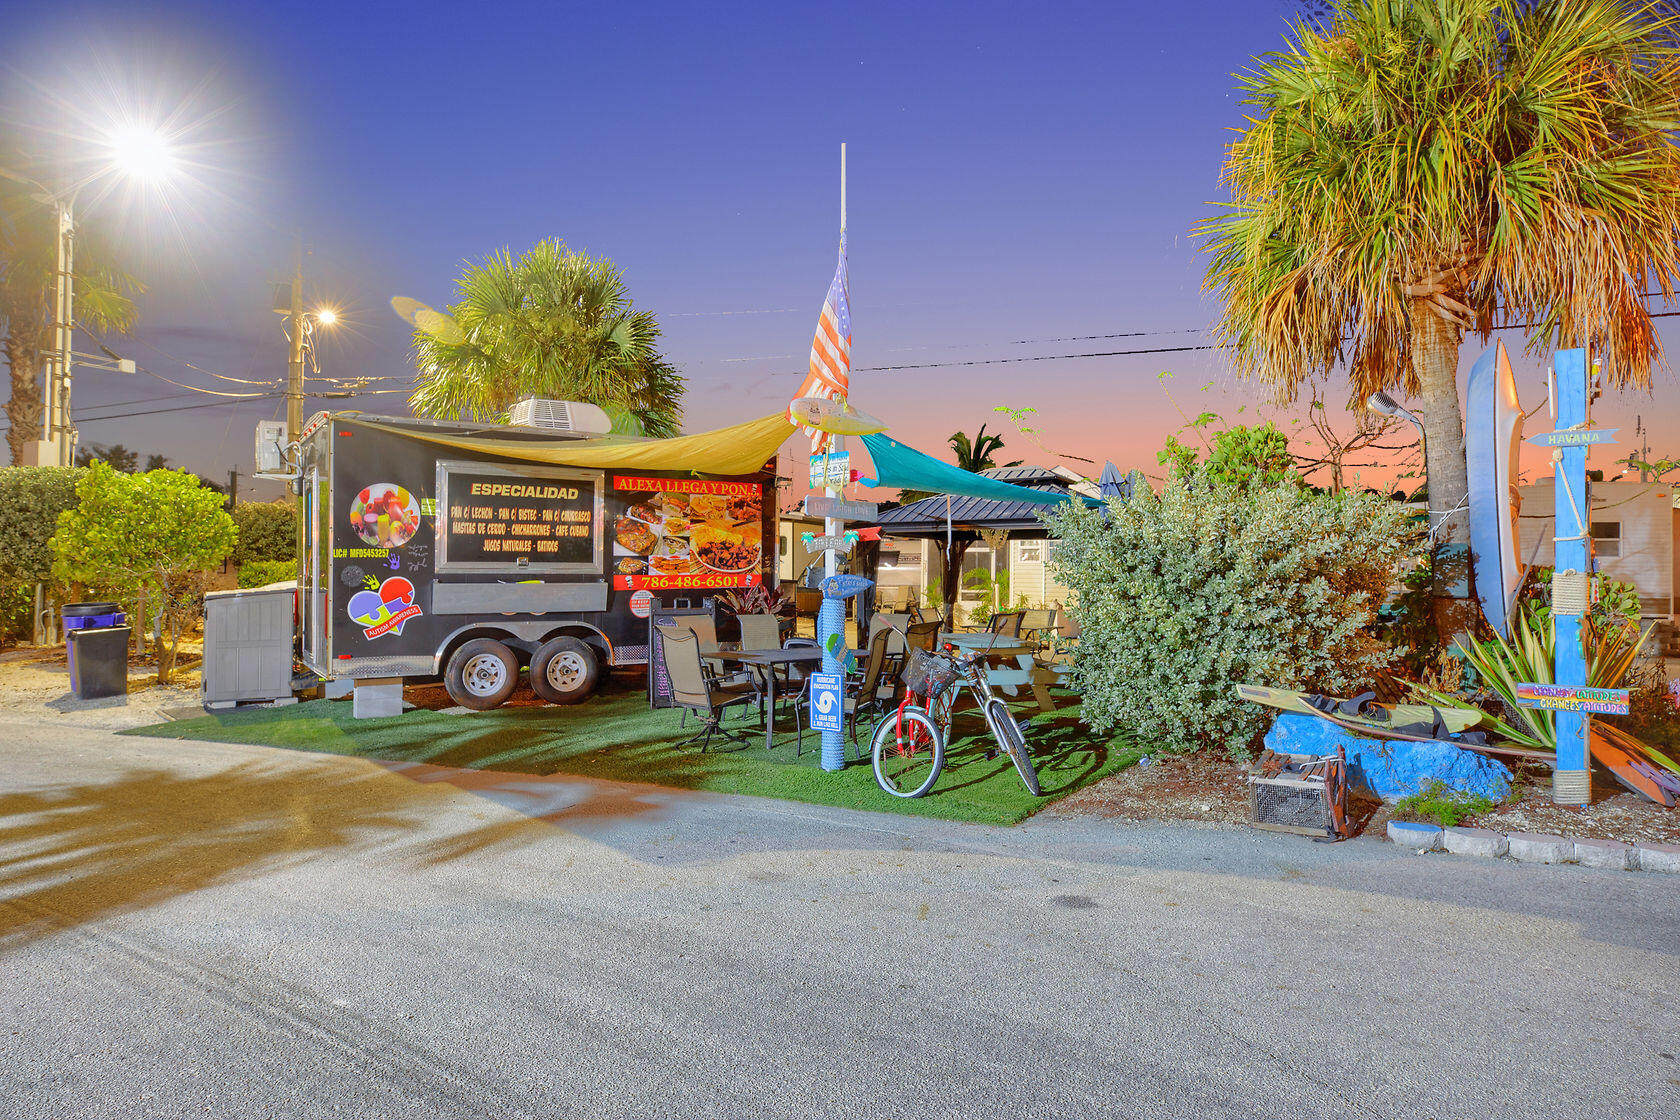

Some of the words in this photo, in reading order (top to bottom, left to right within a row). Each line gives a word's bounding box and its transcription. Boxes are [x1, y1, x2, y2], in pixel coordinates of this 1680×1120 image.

[1548, 433, 1600, 444] HAVANA
[471, 483, 578, 500] ESPECIALIDAD
[619, 478, 664, 492] ALEXA
[666, 480, 708, 494] LLEGA
[709, 482, 718, 494] Y
[451, 506, 462, 518] PAN
[464, 506, 470, 520] C/
[472, 506, 493, 519] LECHON
[498, 508, 510, 520] PAN
[510, 507, 518, 521] C/
[518, 508, 537, 520] BISTEC
[542, 510, 553, 522] PAN
[554, 509, 560, 522] C/
[561, 510, 591, 522] CHURRASCO
[452, 522, 476, 534] MASITAS
[478, 522, 486, 534] DE
[487, 523, 506, 535] CERDO
[512, 524, 550, 536] CHICHARRONES
[570, 525, 589, 537] CUBANO
[333, 549, 348, 558] LIC#
[483, 540, 501, 552] JUGOS
[502, 540, 532, 552] NATURALES
[537, 540, 559, 552] BATIDOS
[641, 576, 738, 588] 786-486-6501
[369, 623, 389, 636] AUTISM
[389, 608, 418, 626] AWARENESS
[1532, 686, 1570, 698] CHANGES
[1576, 690, 1621, 702] LATITUDES
[1540, 698, 1580, 711] CHANGES
[1582, 702, 1626, 714] ATTITUDES
